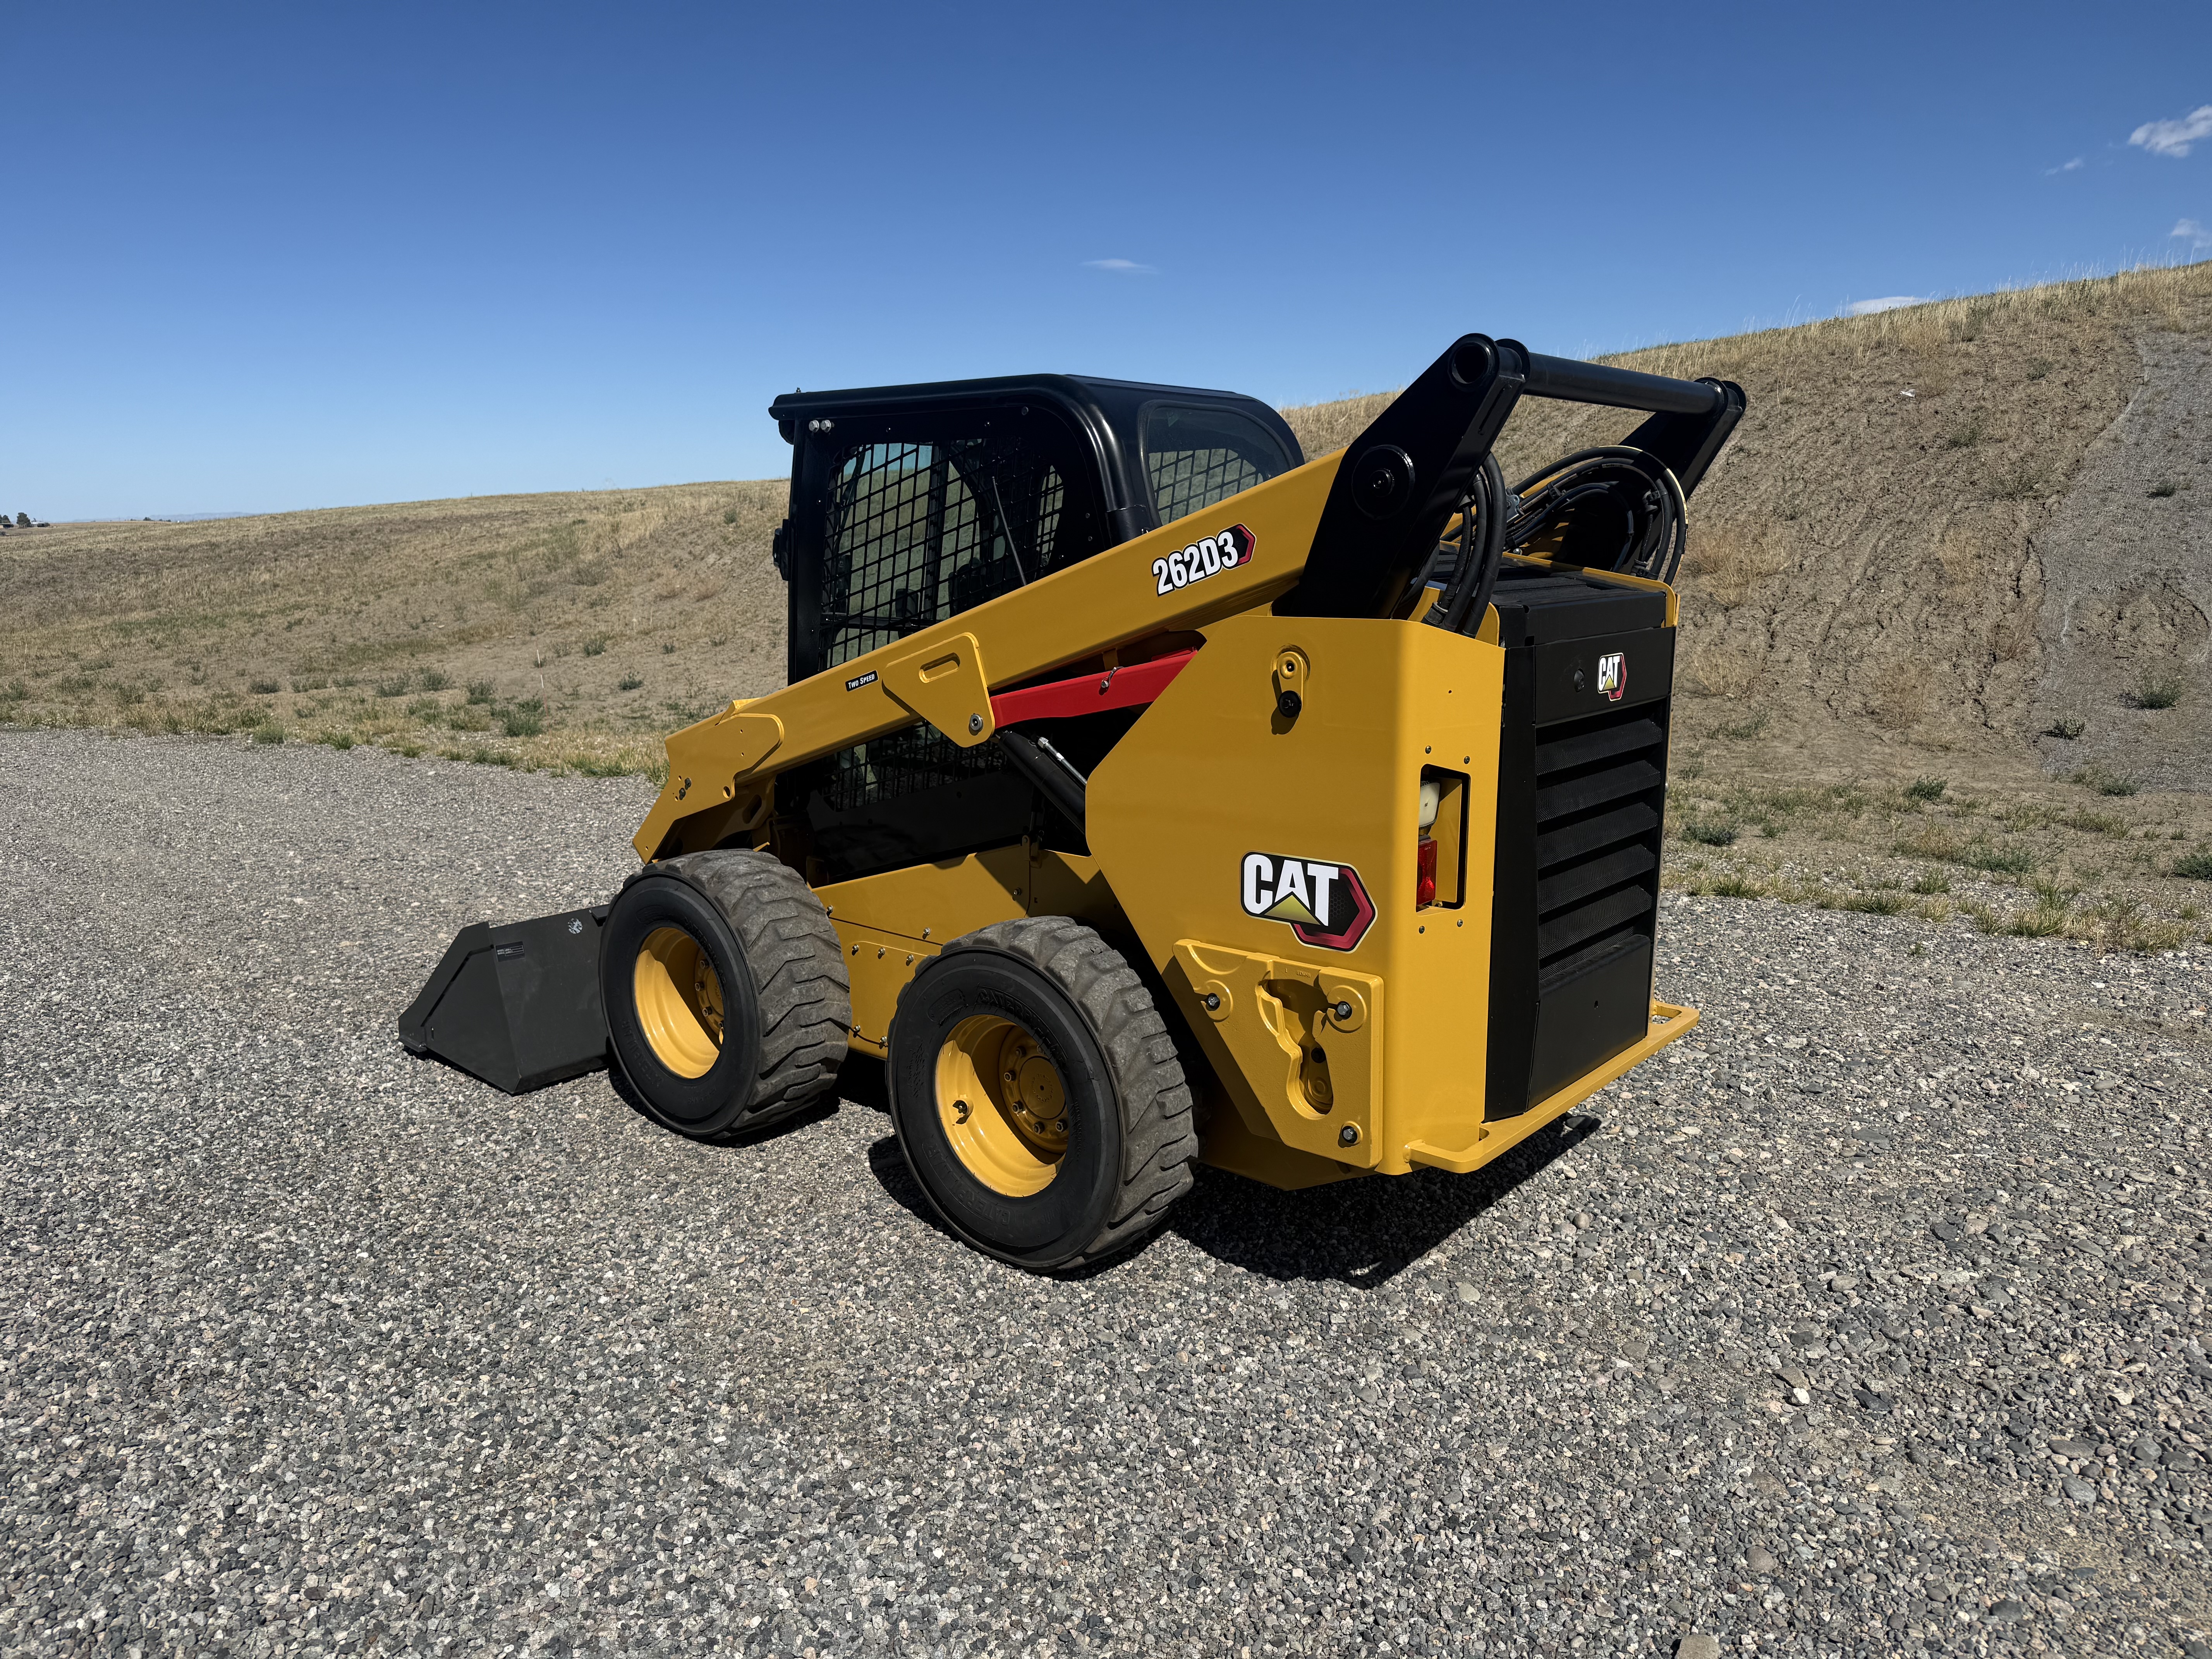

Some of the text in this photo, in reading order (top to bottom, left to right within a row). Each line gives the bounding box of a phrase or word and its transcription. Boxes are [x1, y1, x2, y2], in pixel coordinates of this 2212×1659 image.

[1152, 531, 1238, 595] 262D3
[1598, 655, 1620, 691] CAT
[1243, 854, 1339, 926] CAT
